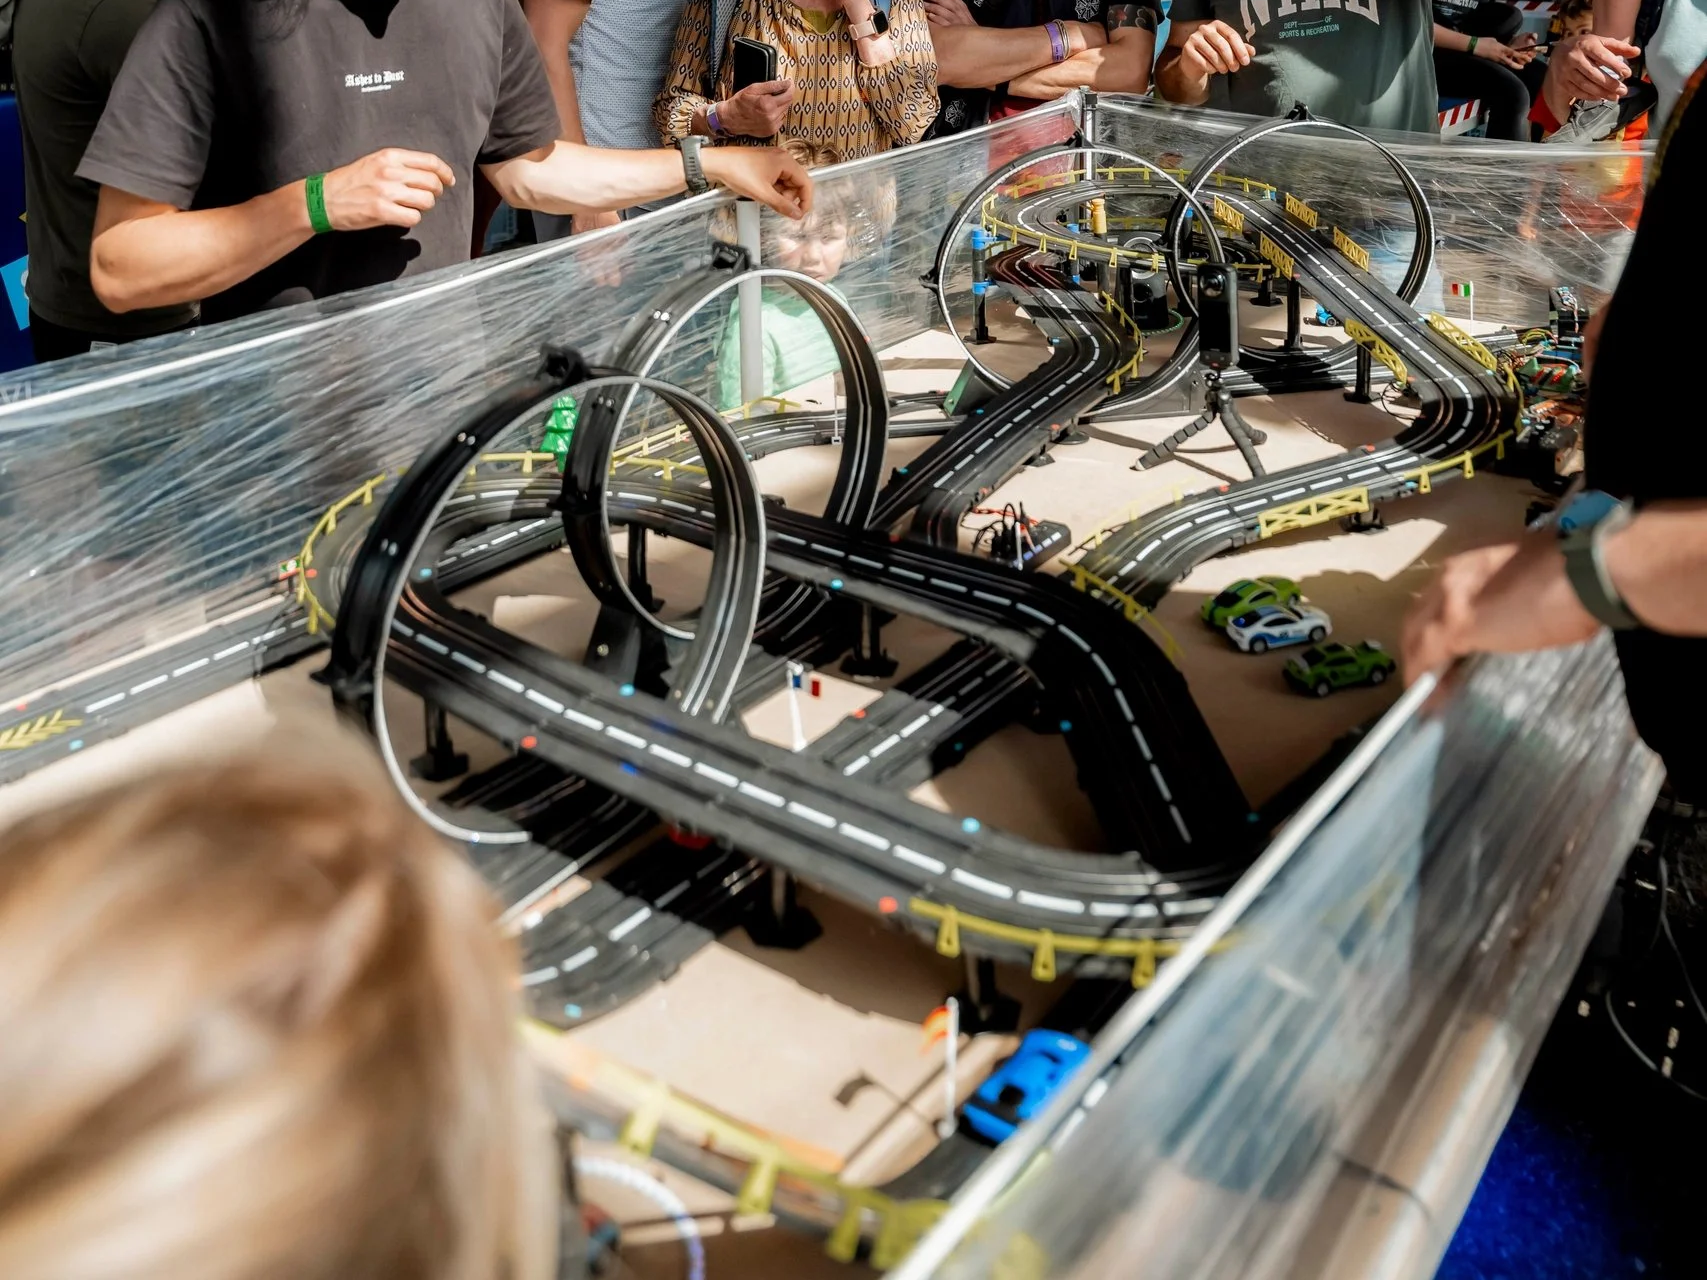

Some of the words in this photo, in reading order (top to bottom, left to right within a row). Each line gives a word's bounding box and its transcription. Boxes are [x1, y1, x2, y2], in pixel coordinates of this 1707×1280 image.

[1283, 21, 1298, 29] DEPT
[1324, 15, 1333, 23] OF
[1278, 30, 1300, 39] SPORTS
[1300, 29, 1306, 37] &
[1305, 23, 1340, 36] RECREATION
